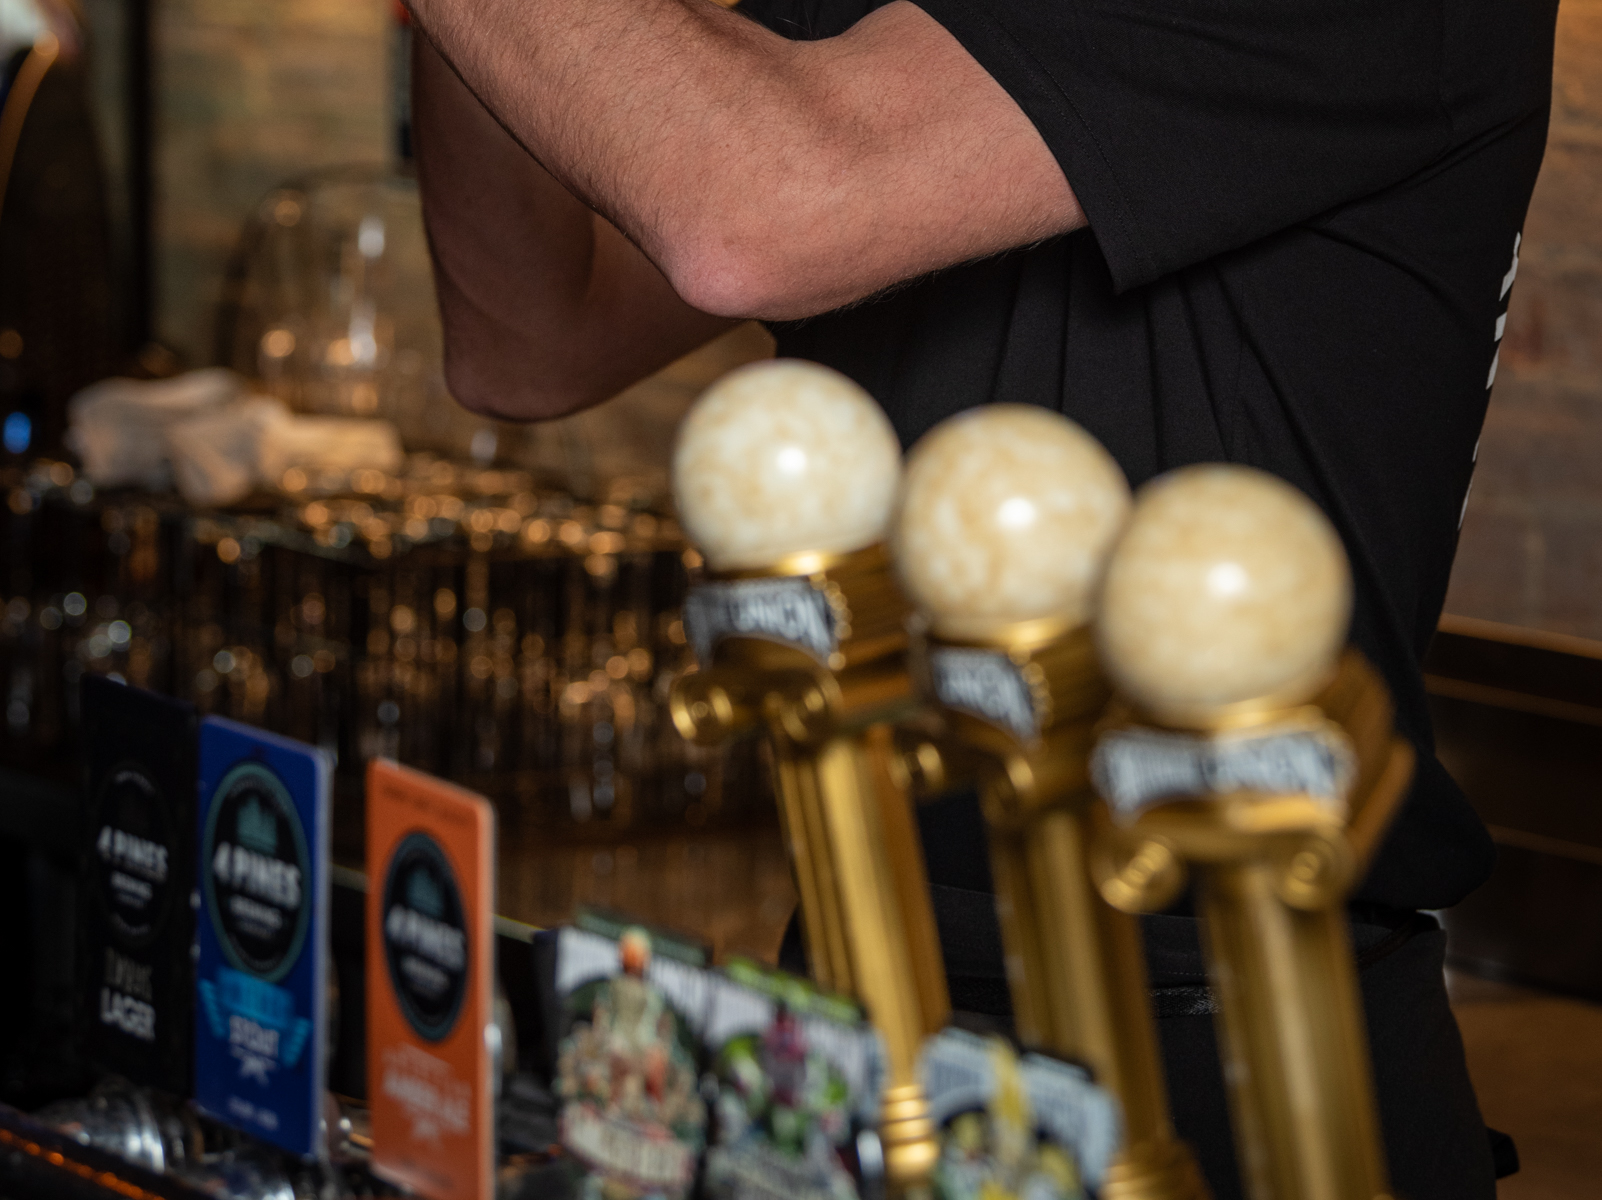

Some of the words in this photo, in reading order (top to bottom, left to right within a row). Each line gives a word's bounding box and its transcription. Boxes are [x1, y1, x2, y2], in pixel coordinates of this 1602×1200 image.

[113, 829, 168, 882] PINES
[232, 846, 301, 910] PINES
[100, 987, 155, 1041] LAGER
